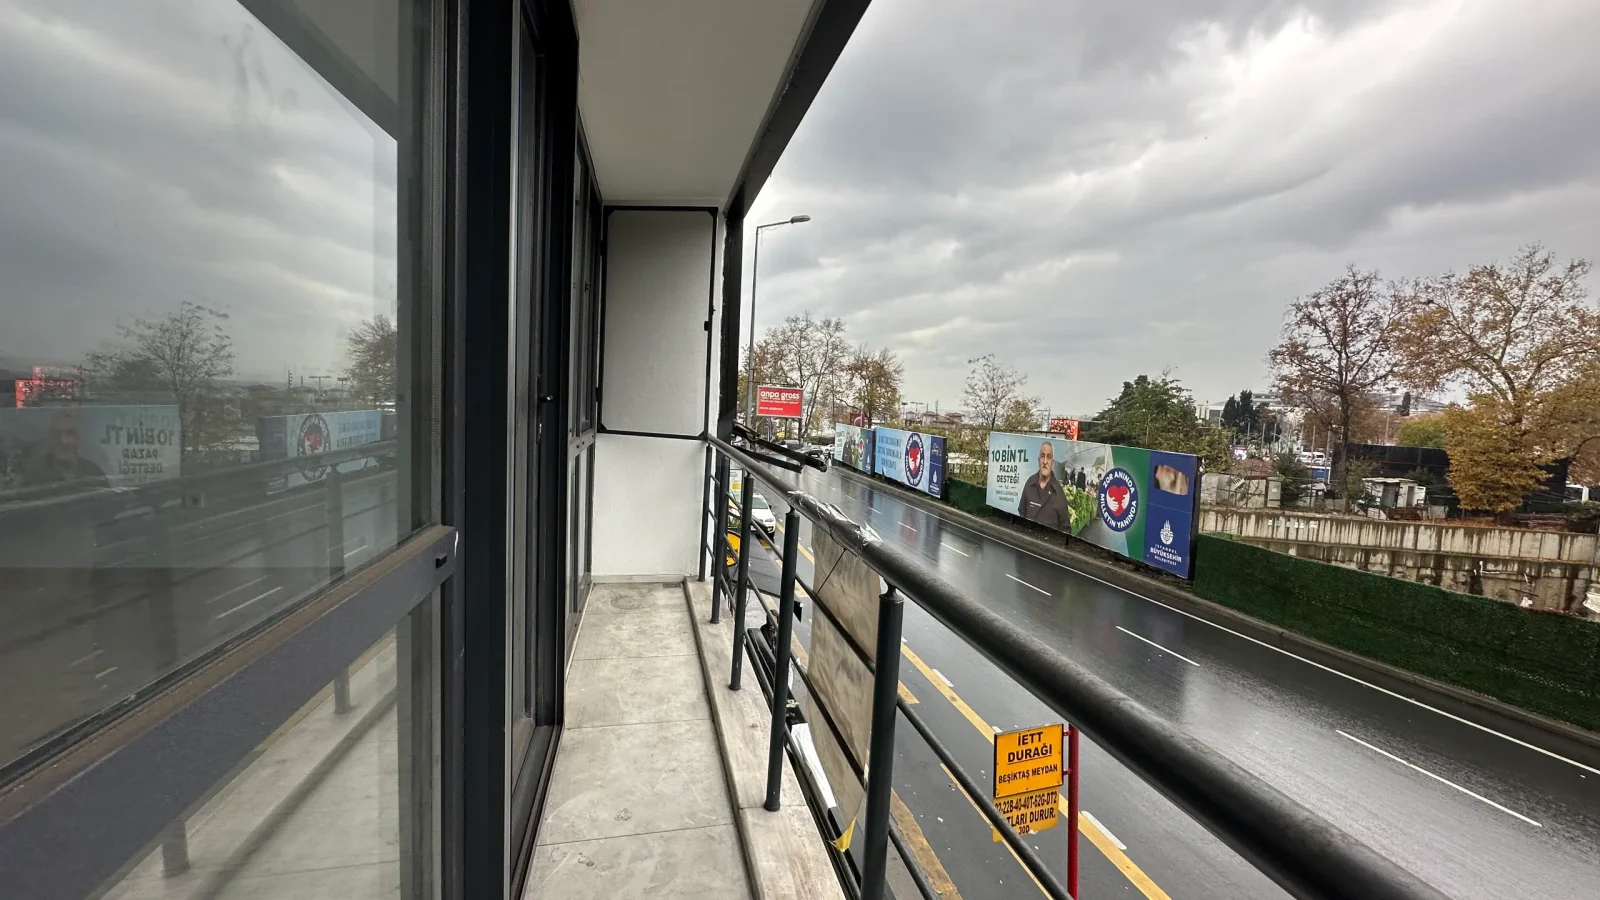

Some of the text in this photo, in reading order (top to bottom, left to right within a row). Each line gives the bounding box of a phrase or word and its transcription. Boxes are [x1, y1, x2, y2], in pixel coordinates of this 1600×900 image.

[760, 391, 799, 401] anpa gross
[991, 445, 1029, 463] 10 BİN TL
[999, 464, 1018, 474] PAZAR
[996, 473, 1020, 484] DESTEĞİ
[1103, 471, 1135, 494] ZOR ANINDA
[1100, 493, 1137, 528] MİLLETİN YANINDA
[1017, 731, 1044, 746] İETT
[1007, 743, 1052, 763] DURAĞI
[998, 763, 1058, 784] BEŞİKTAŞ MEYDAN
[1006, 812, 1028, 827] TLARI
